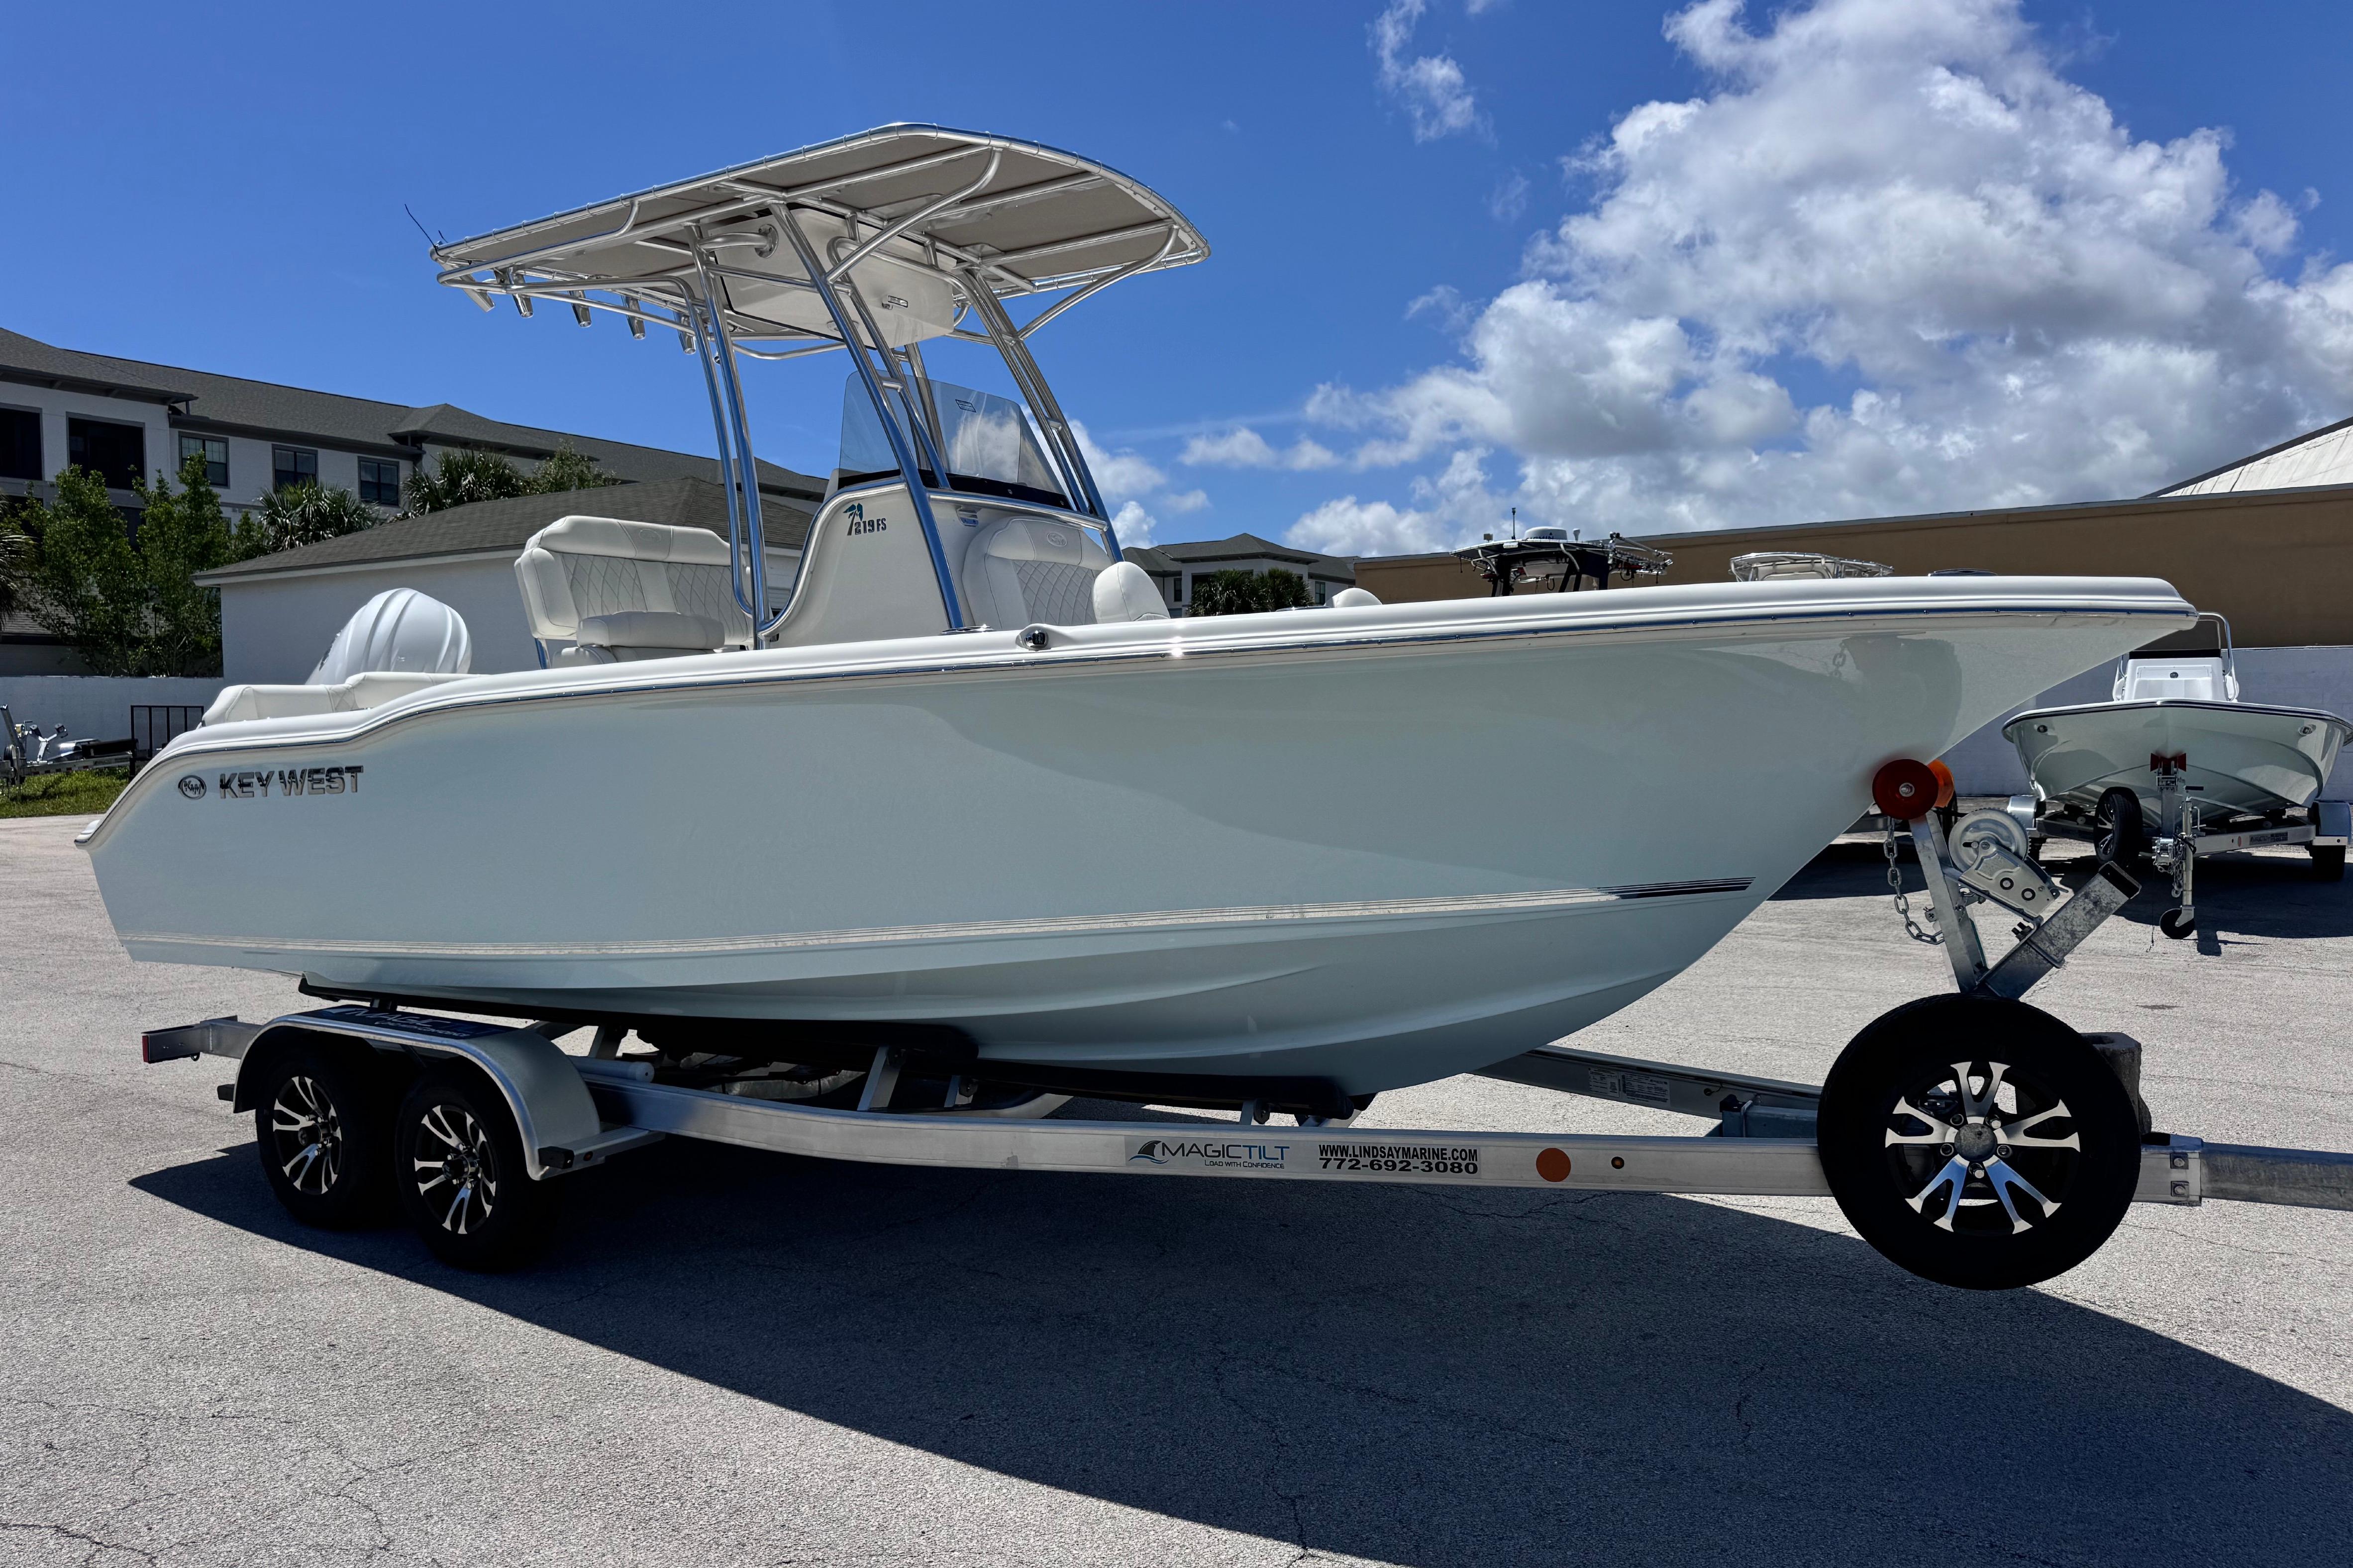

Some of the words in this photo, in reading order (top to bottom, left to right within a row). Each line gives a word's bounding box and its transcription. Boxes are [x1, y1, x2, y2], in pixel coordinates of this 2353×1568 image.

[854, 519, 874, 535] 219
[877, 518, 887, 531] FS
[219, 771, 274, 799] KEY
[279, 765, 364, 796] WEST
[1162, 1142, 1290, 1161] MAGICTILT
[1319, 1144, 1478, 1162] WWW.LINDSAYMARINE.COM
[1319, 1158, 1478, 1175] 772-692-3080
